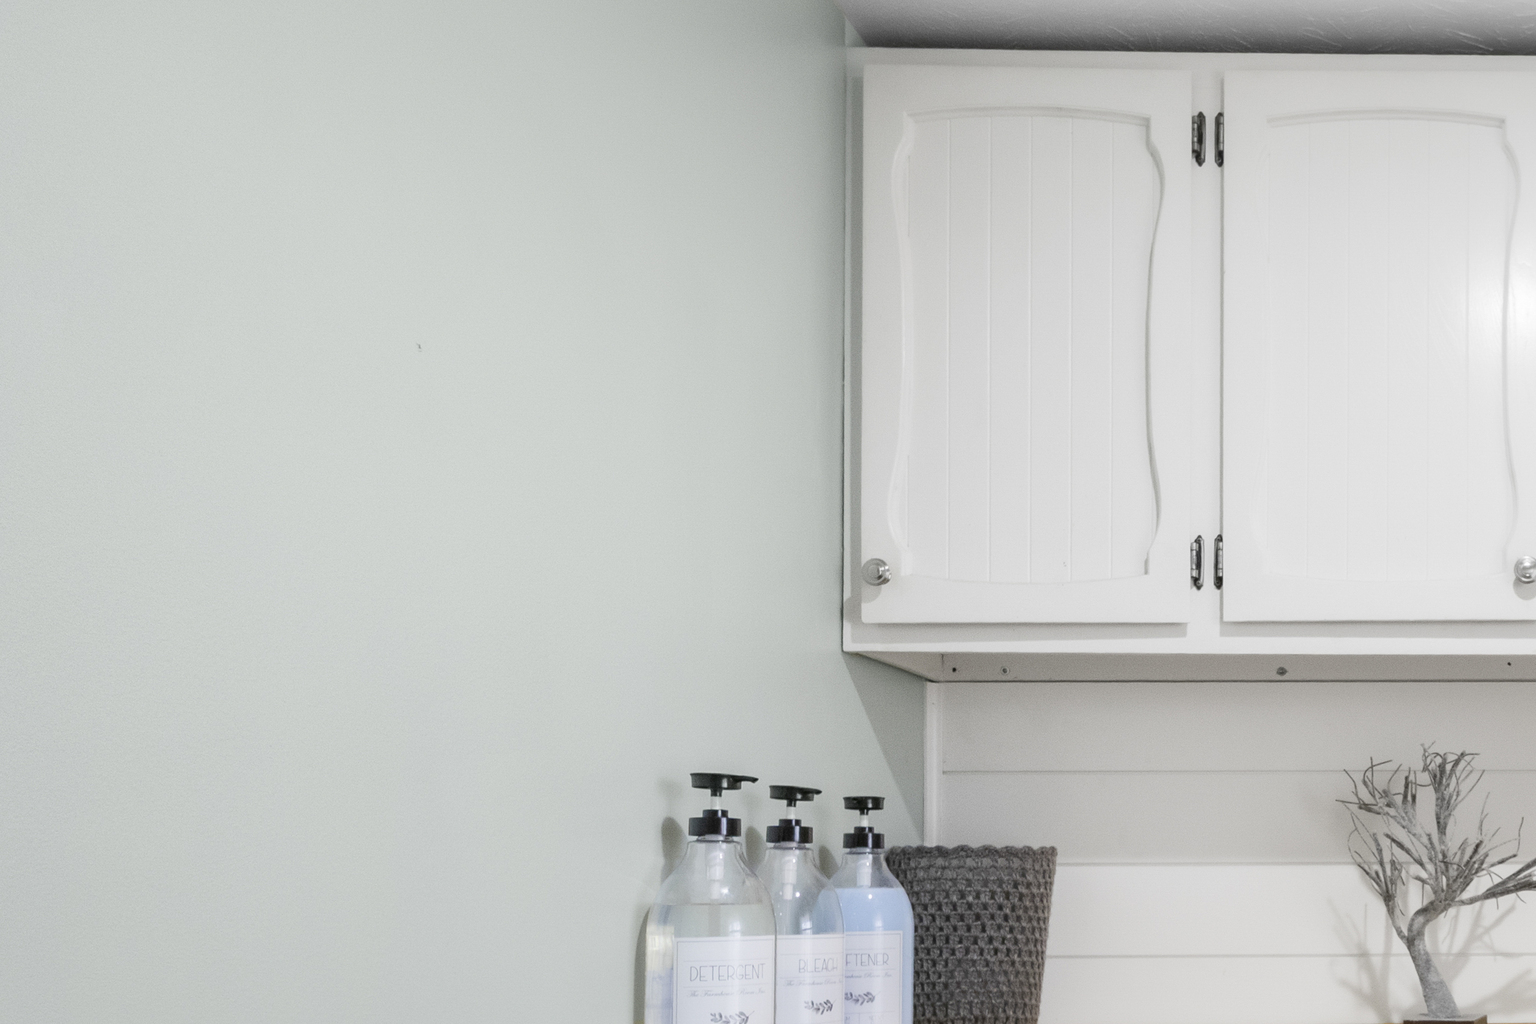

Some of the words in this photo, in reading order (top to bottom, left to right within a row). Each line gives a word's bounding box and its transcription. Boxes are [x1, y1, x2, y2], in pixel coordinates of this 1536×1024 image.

[798, 958, 838, 973] BLEACH
[845, 953, 889, 966] FTENER
[690, 963, 766, 982] DETERGENT
